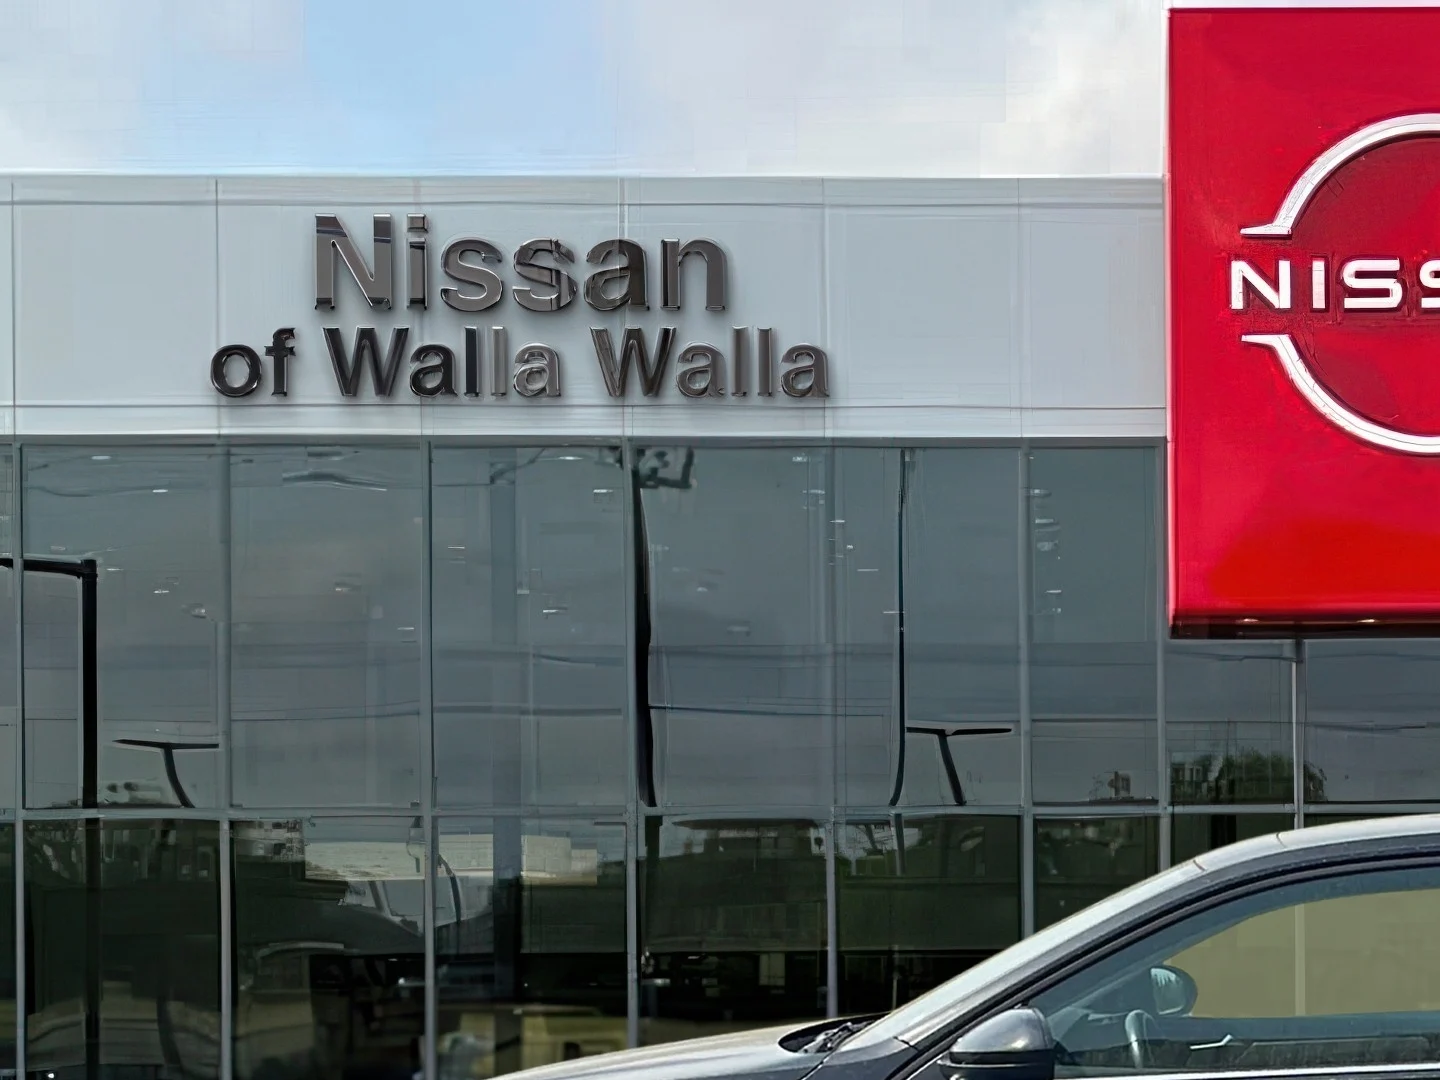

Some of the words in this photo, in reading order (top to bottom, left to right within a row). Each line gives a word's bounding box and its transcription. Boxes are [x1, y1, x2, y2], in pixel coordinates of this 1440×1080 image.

[314, 213, 727, 311] Nissan
[210, 327, 296, 398] of
[322, 326, 562, 398] Walla
[590, 326, 830, 398] Walla
